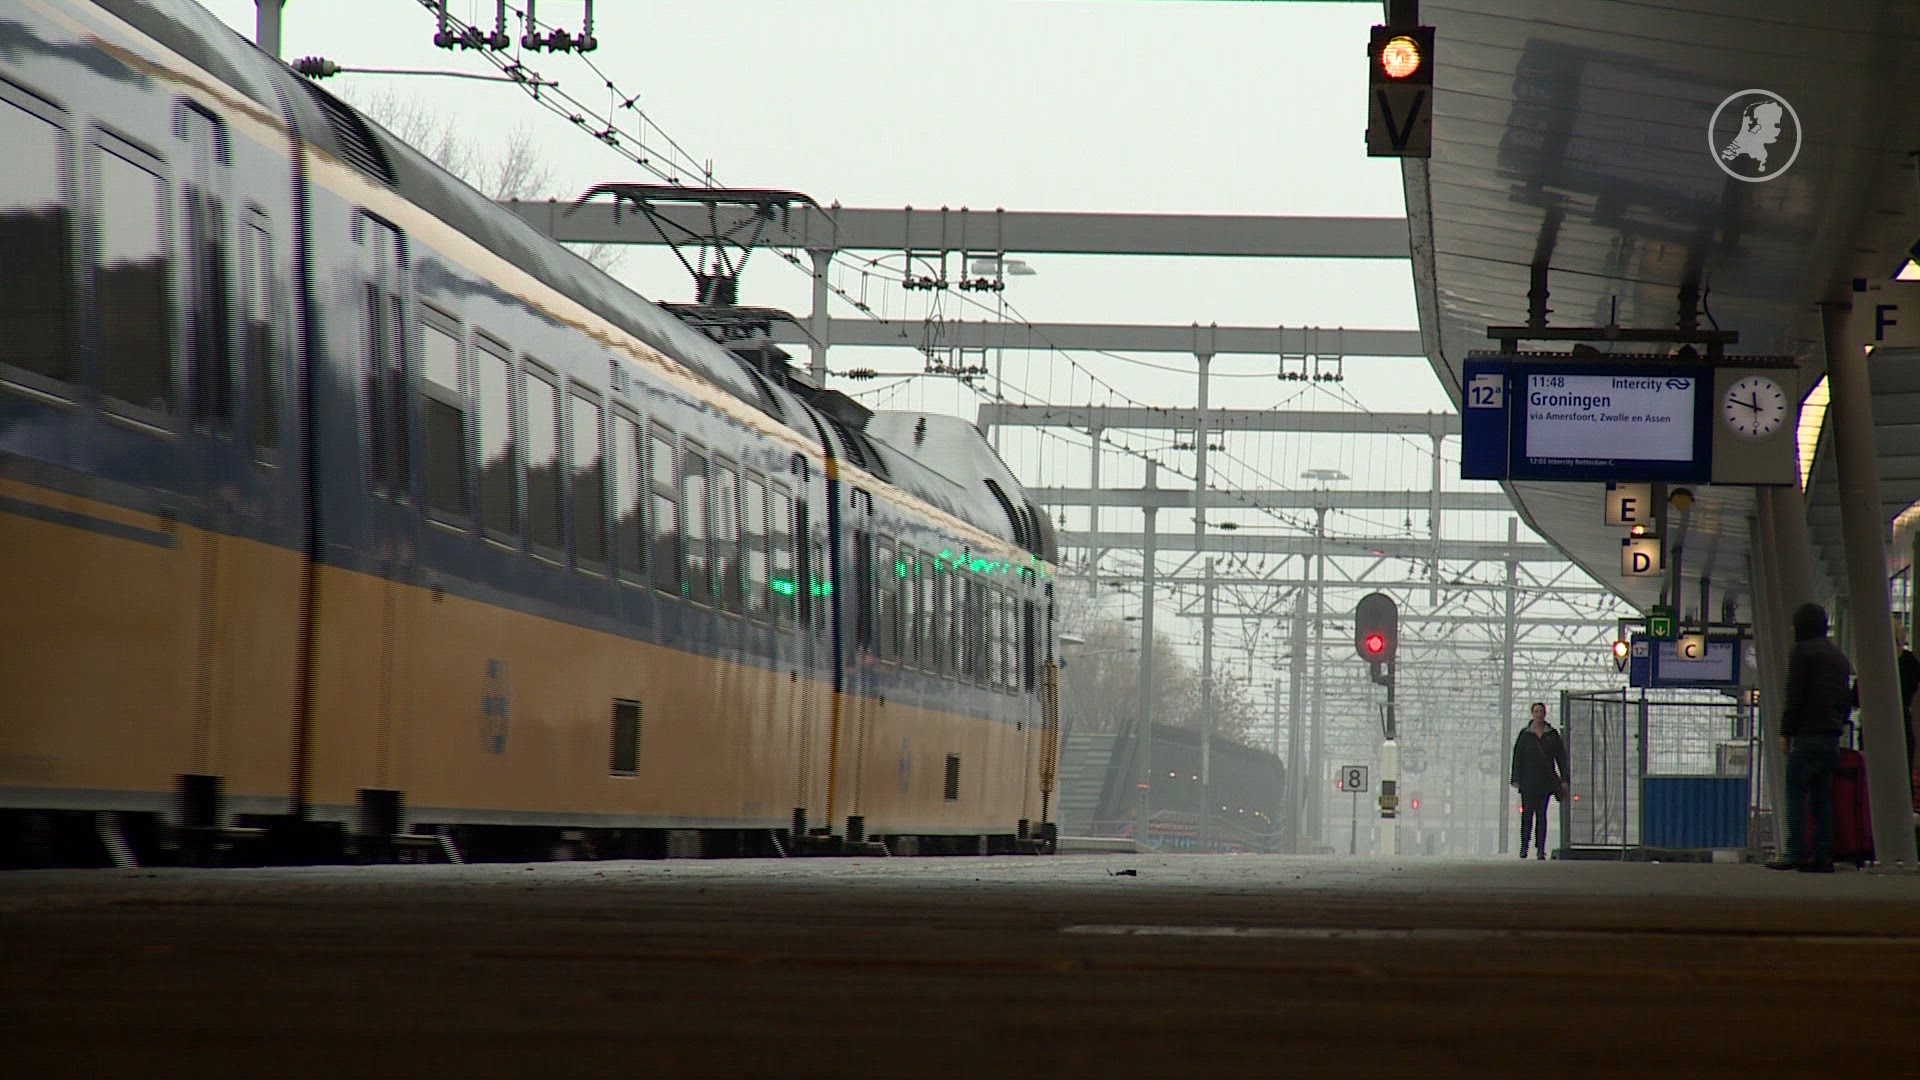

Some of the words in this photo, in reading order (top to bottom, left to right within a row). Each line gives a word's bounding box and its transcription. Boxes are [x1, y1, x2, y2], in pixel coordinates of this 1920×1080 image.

[1377, 89, 1425, 151] V
[1876, 304, 1898, 341] F
[1532, 376, 1565, 388] 11:48
[1612, 378, 1662, 392] Intercity
[1530, 391, 1611, 411] Groningen
[1530, 412, 1543, 420] via
[1545, 412, 1597, 422] Amersfoort,
[1600, 413, 1629, 422] Zwolle
[1645, 414, 1671, 423] Assen
[1621, 498, 1637, 522] E
[1633, 552, 1651, 573] D
[1685, 644, 1697, 659] C
[1615, 658, 1628, 673] V
[1348, 769, 1361, 788] 8
